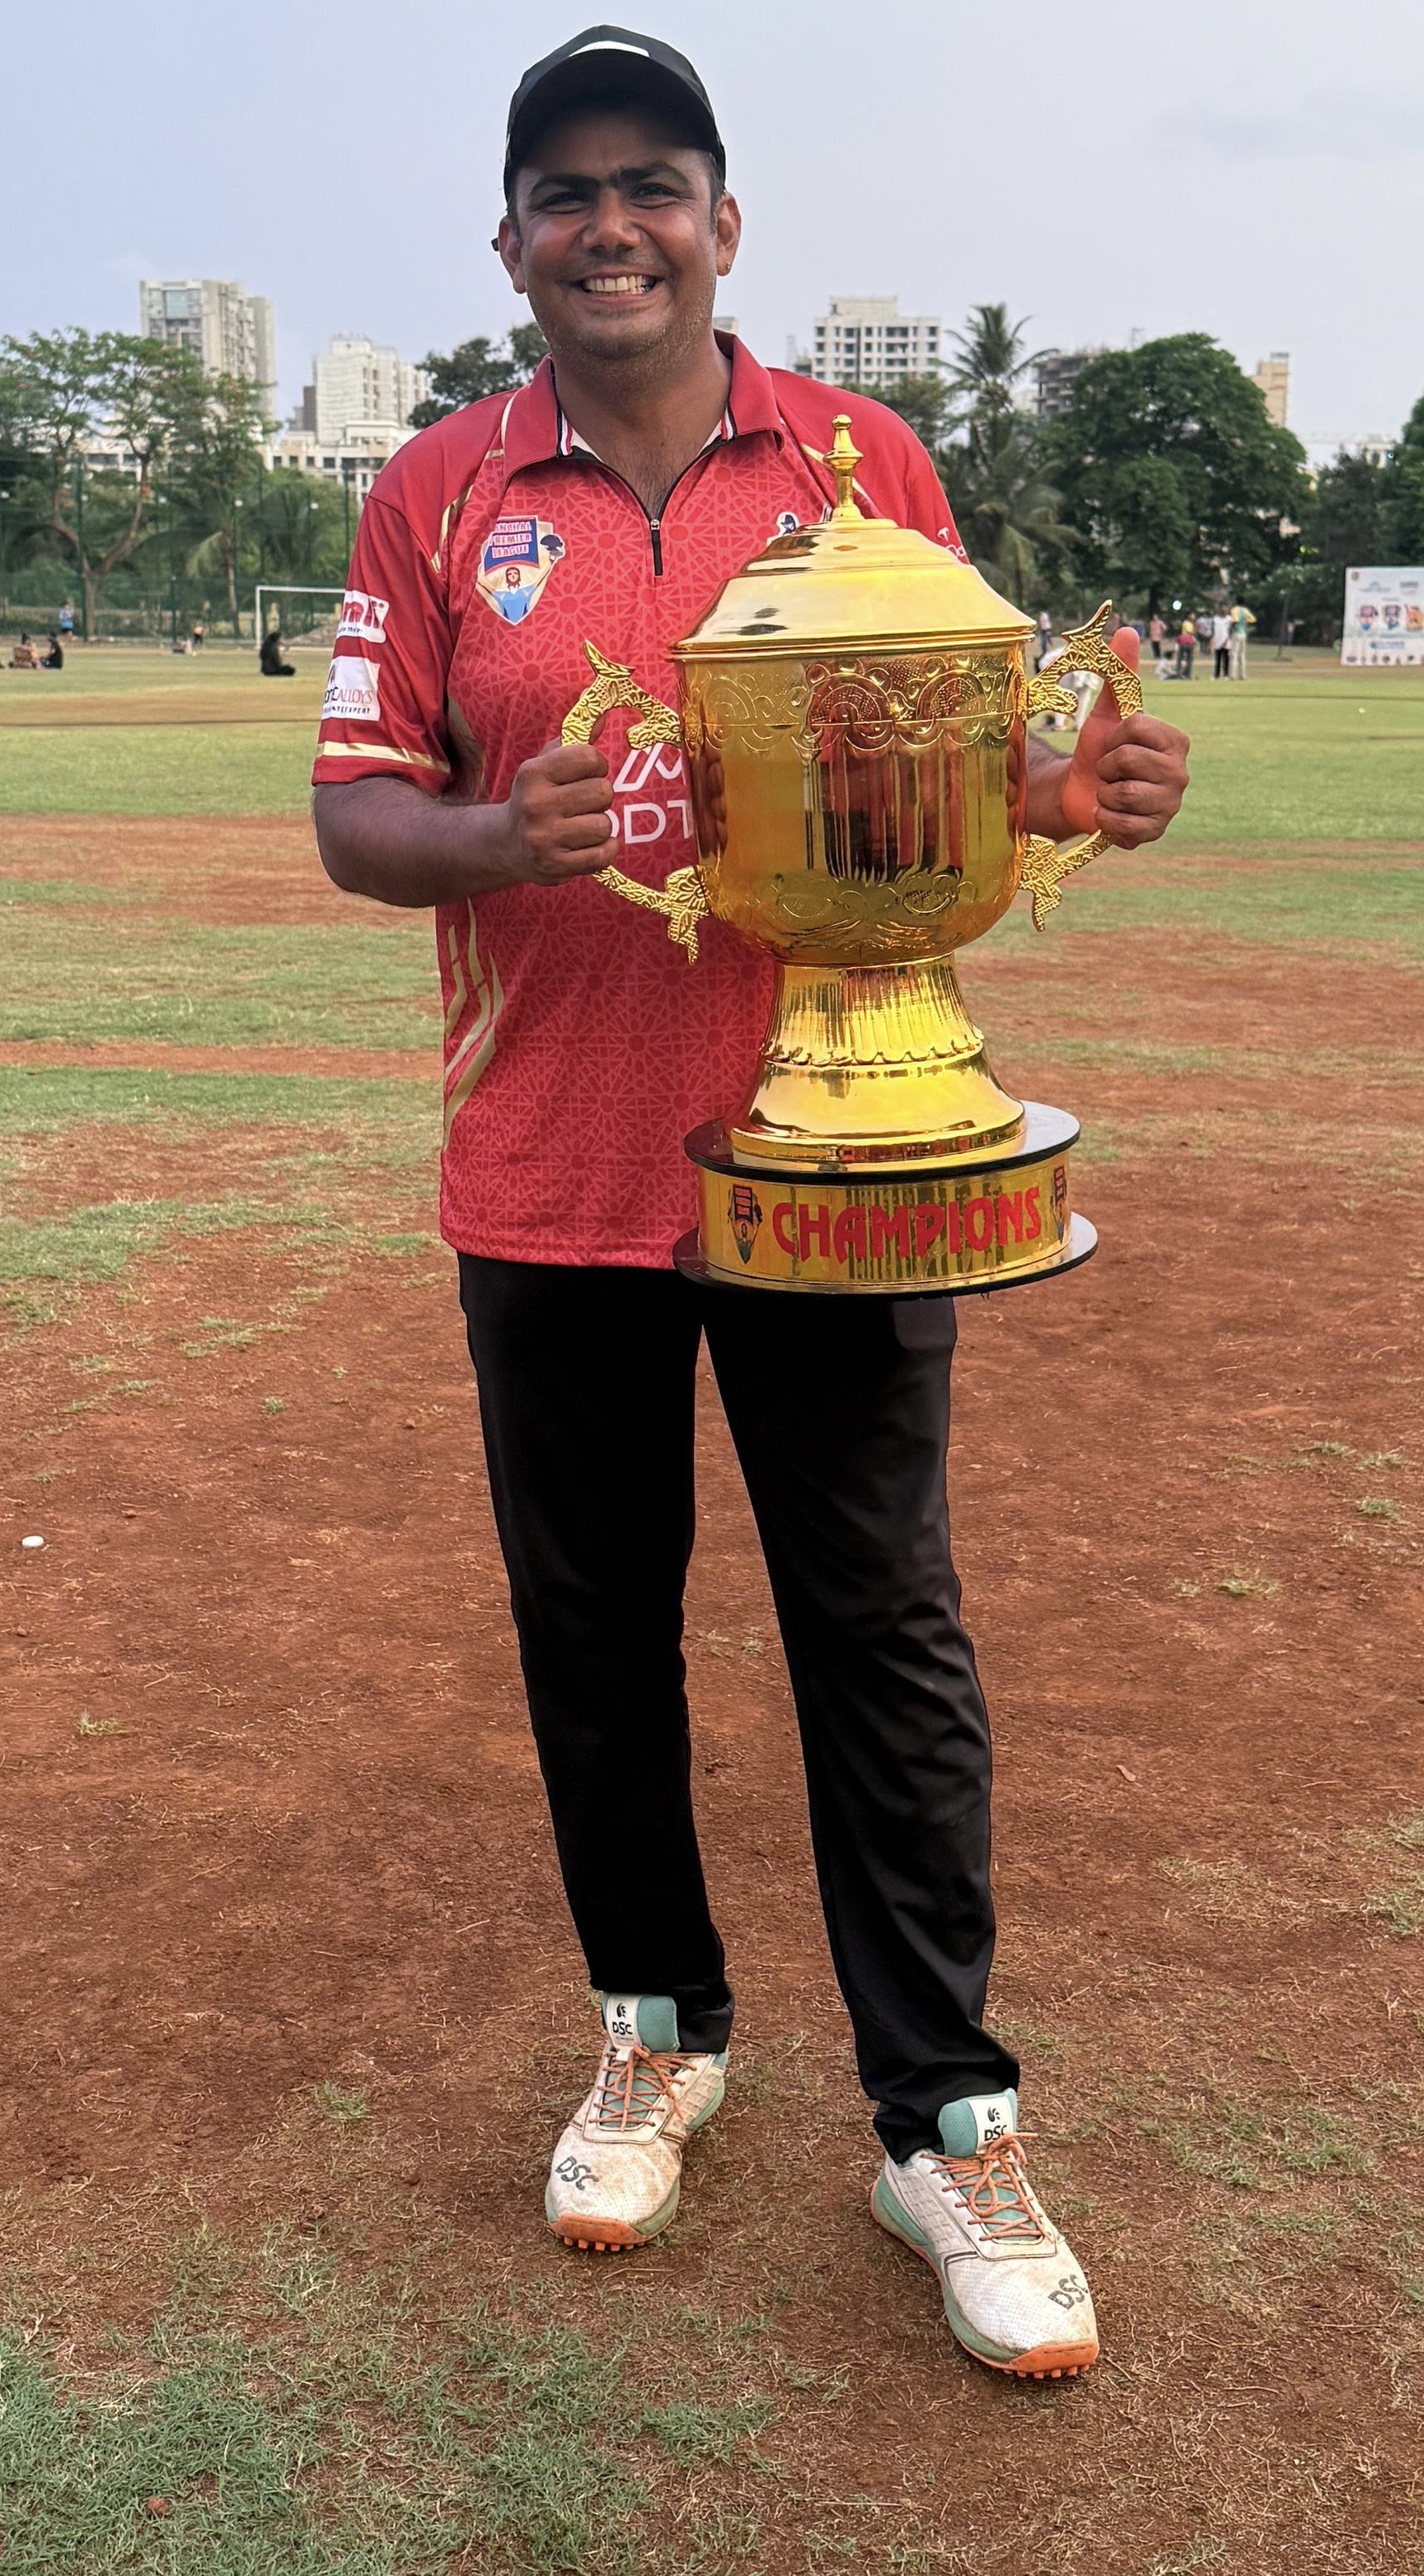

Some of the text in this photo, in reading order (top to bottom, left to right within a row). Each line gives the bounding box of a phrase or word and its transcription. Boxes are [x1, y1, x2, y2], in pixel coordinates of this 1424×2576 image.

[772, 1186, 1041, 1265] CHAMPIONS
[612, 2022, 633, 2035] DSC
[984, 2125, 1007, 2141] DSC
[555, 2155, 599, 2190] DSC
[1047, 2274, 1089, 2312] DSC
